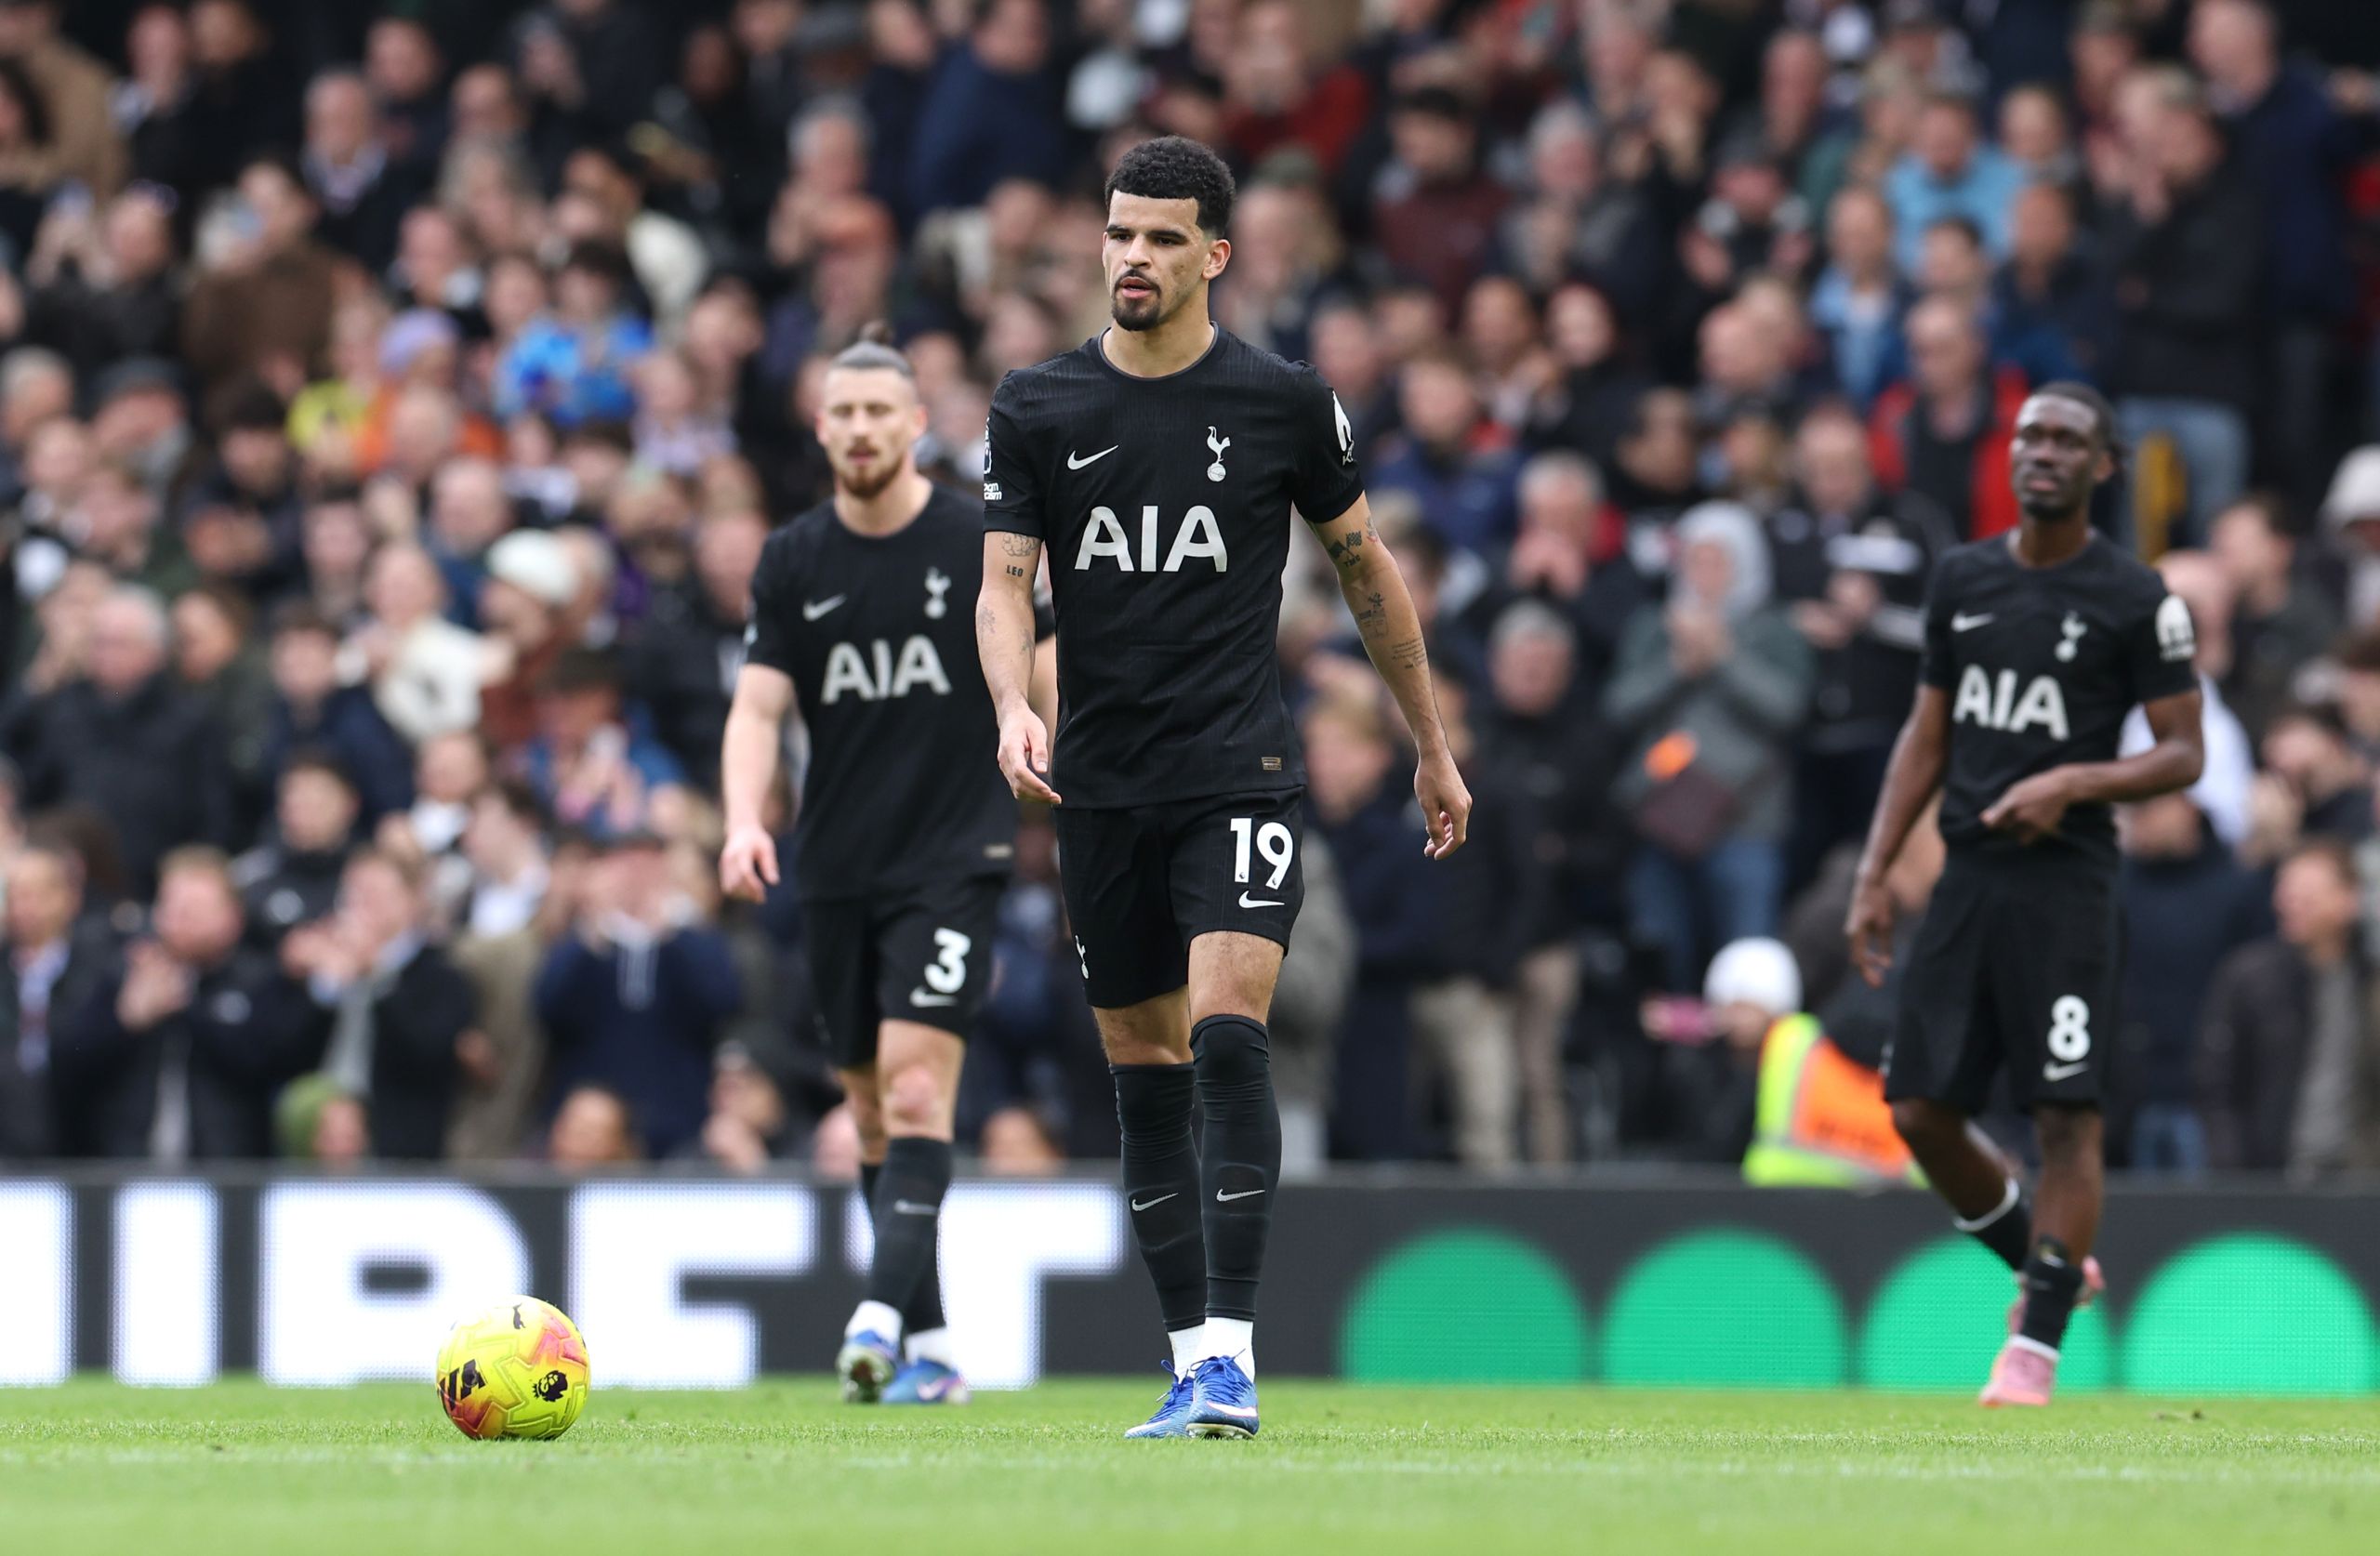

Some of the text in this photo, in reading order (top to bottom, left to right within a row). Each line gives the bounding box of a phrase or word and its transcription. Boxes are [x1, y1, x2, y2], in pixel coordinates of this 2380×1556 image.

[1007, 565, 1024, 577] LEO
[1075, 506, 1226, 573] AIA
[821, 633, 953, 705] AIA
[1953, 664, 2069, 742] AIA
[1230, 818, 1293, 890] 19
[924, 928, 971, 994] 3
[2047, 995, 2090, 1061] 8
